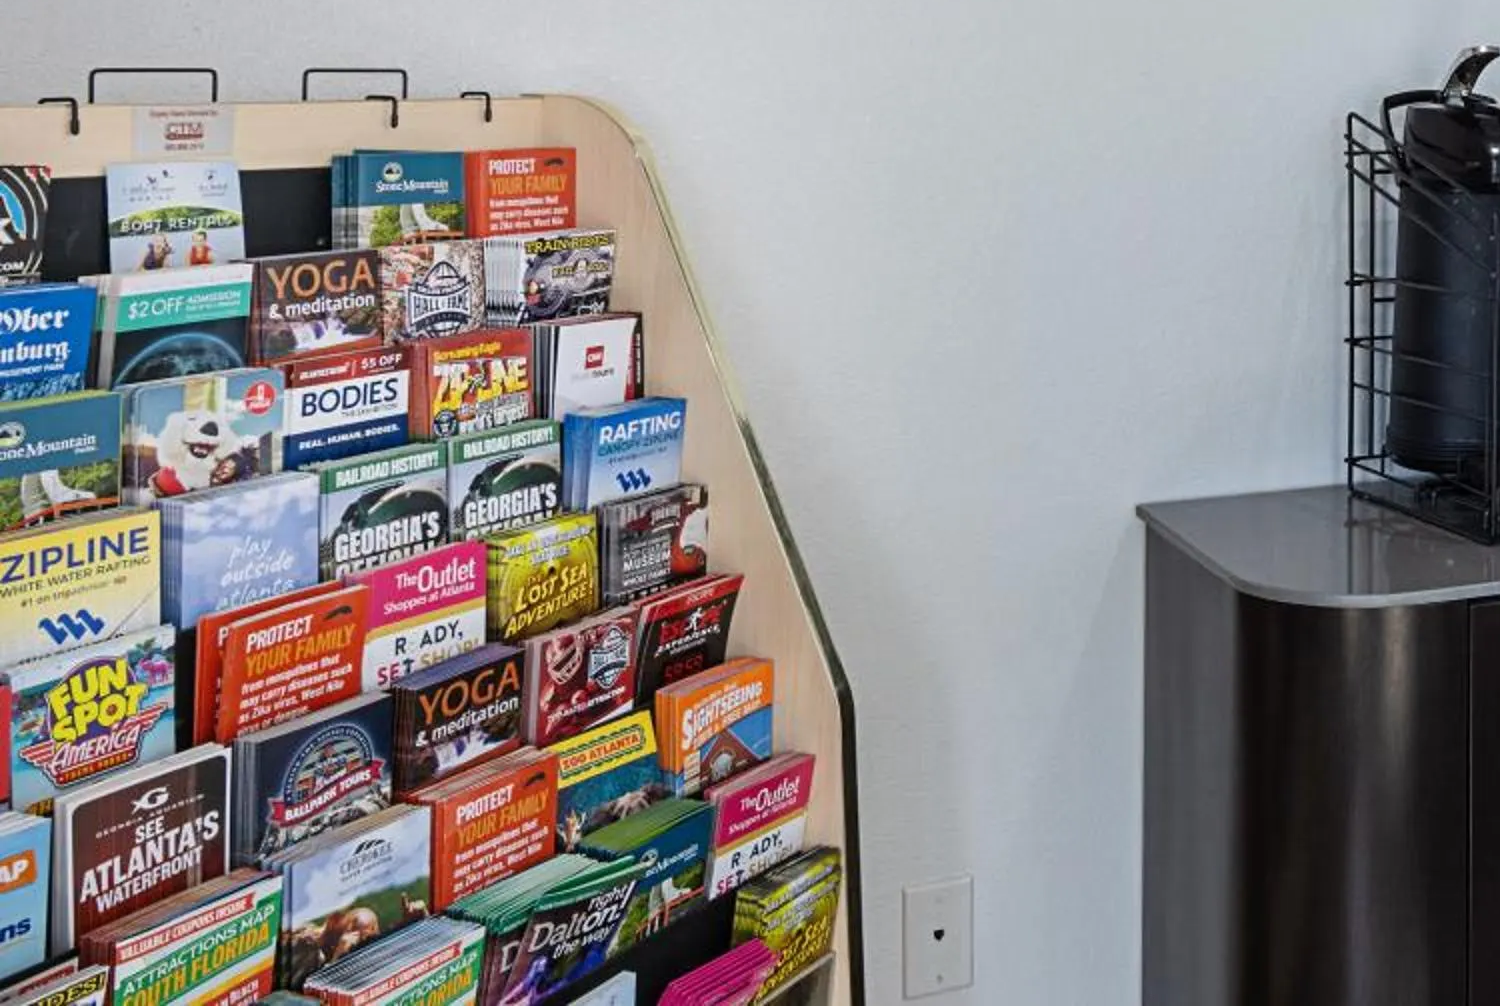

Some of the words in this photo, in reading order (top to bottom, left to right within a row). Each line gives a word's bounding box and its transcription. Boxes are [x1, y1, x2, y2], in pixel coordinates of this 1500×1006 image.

[488, 158, 536, 176] PROTECT
[490, 176, 524, 196] YOUR
[525, 173, 568, 194] FAMILY
[267, 257, 375, 299] YOGA
[128, 301, 149, 320] $2
[151, 296, 185, 316] OFF
[269, 303, 283, 320] &
[285, 293, 375, 318] meditation
[0, 340, 70, 364] nburg
[301, 378, 399, 417] BODIES
[26, 433, 97, 459] Mountain
[463, 435, 510, 460] RAILROAD
[511, 426, 554, 450] HISTORY!
[599, 410, 681, 445] RAFTING
[335, 462, 389, 489] RAILROAD
[390, 450, 440, 476] HISTORY!
[465, 482, 558, 529] GEORGIA'S
[0, 526, 150, 585] ZIPLINE
[336, 511, 441, 563] GEORGIA'S
[48, 568, 93, 587] WATER
[96, 555, 151, 575] RAFTING
[221, 548, 295, 587] outside
[395, 571, 417, 591] The
[417, 557, 477, 593] Outlet
[515, 575, 559, 613] LOST
[560, 562, 587, 593] SEA
[383, 594, 427, 616] Shoppes
[440, 581, 476, 598] Atlanta
[503, 577, 593, 639] ADVENTURE!
[245, 645, 291, 678] YOUR
[300, 622, 357, 660] FAMILY
[246, 613, 314, 654] PROTECT
[49, 656, 129, 721] FUN
[418, 660, 521, 725] YOGA
[51, 683, 148, 745] SPOT
[415, 730, 428, 747] &
[431, 696, 519, 742] meditation
[51, 725, 142, 773] AMERICA
[561, 751, 588, 771] ZOO
[589, 731, 641, 762] ATLANTA
[285, 784, 338, 822] BALLPARK
[339, 768, 372, 793] TOURS
[456, 784, 515, 825] PROTECT
[135, 816, 165, 844] SEE
[456, 814, 498, 847] YOUR
[502, 789, 550, 830] FAMILY
[79, 809, 220, 904] ATLANTA'S
[95, 845, 204, 913] WATERFRONT
[125, 923, 237, 996] ATTRACTIONS
[240, 903, 275, 931] MAP
[191, 921, 270, 982] FLORIDA
